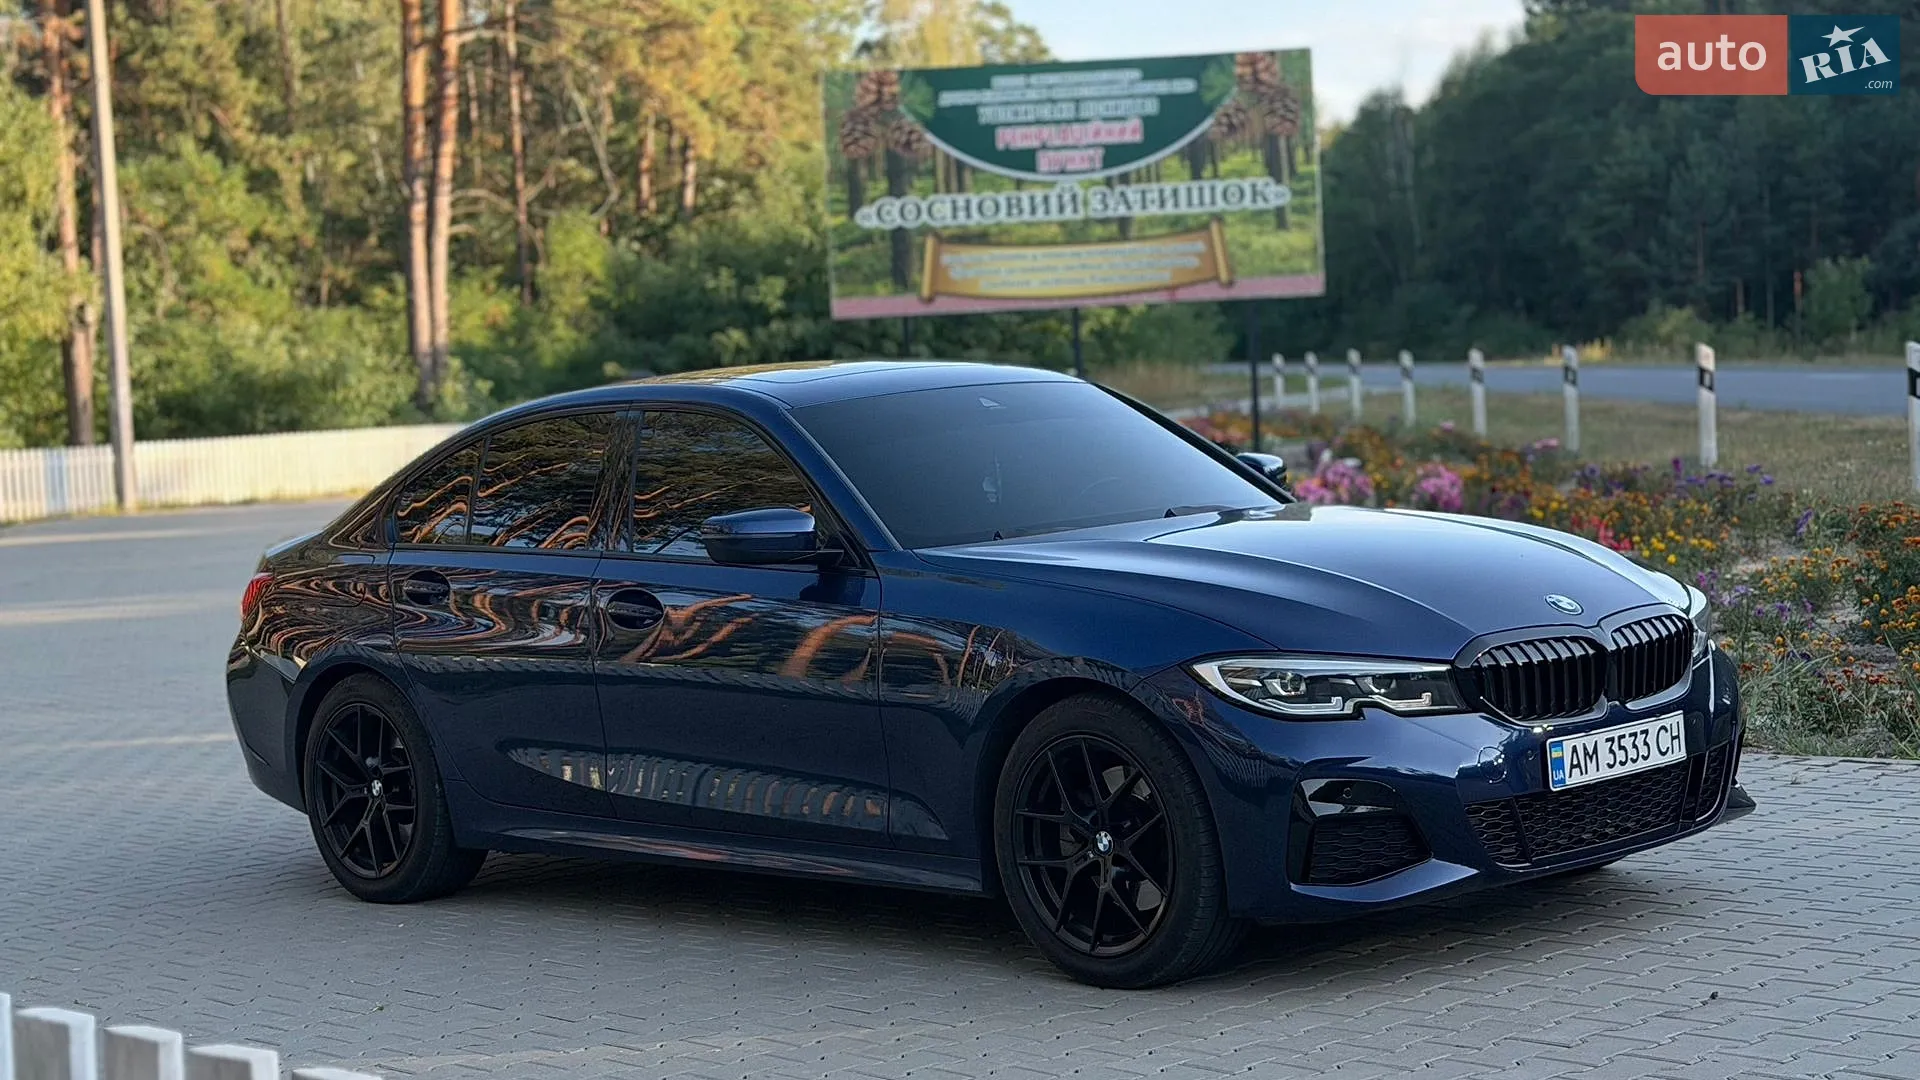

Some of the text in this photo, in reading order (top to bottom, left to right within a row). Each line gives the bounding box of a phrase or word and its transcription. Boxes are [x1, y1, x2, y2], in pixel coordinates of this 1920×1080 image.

[858, 186, 1081, 226] «СОСНОВИЙ
[1568, 721, 1682, 779] AM 3533 CH
[1553, 769, 1565, 781] UA
